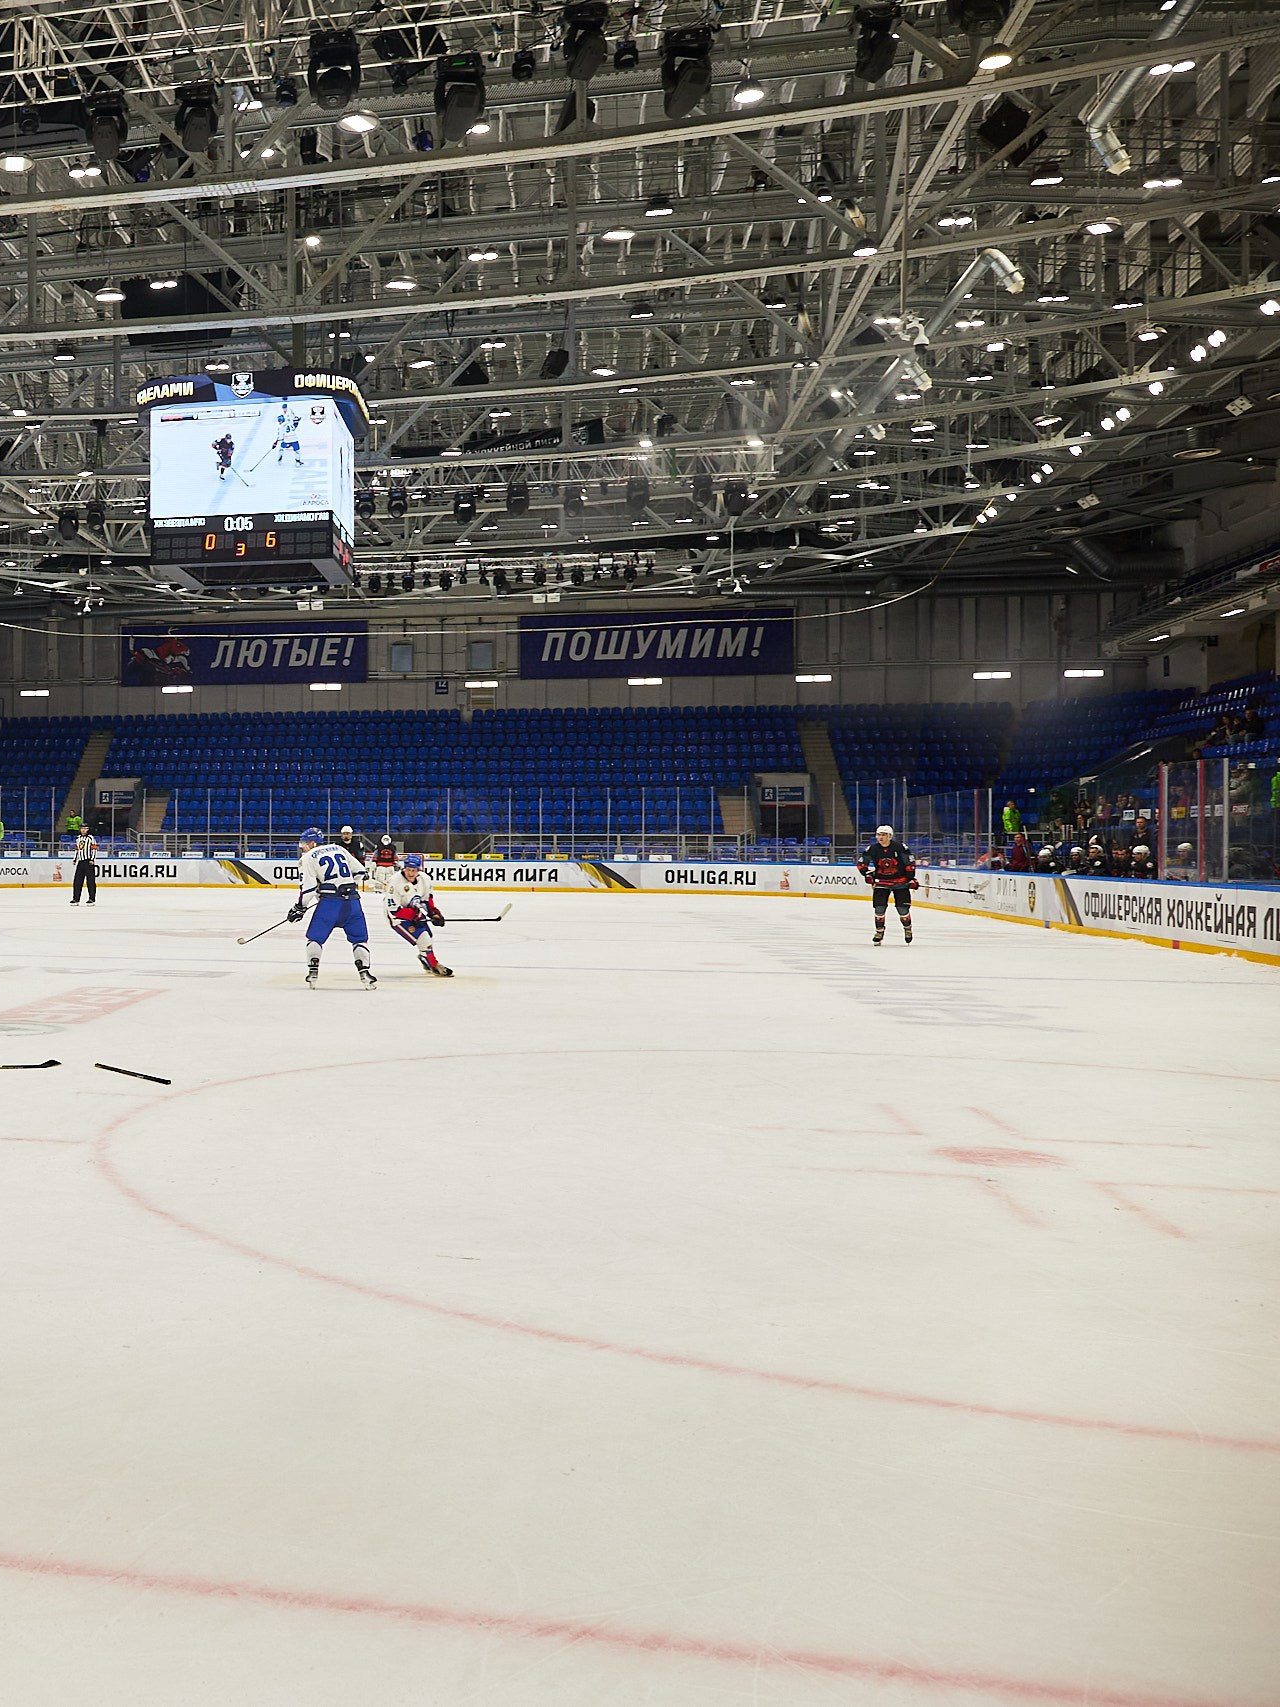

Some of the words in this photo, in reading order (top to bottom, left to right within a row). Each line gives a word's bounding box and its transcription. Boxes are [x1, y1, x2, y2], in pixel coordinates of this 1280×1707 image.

[534, 437, 560, 446] ЛИГИ
[223, 516, 254, 532] 0:05
[205, 533, 216, 550] 0
[265, 531, 276, 547] 6
[236, 543, 246, 556] 3
[210, 637, 355, 669] ЛЮТЫЕ!
[541, 627, 764, 662] ПОШУМИМ!
[320, 853, 351, 881] 26
[425, 863, 506, 882] ККЕЙНАЯ
[513, 868, 559, 882] ЛИГА
[665, 869, 756, 886] OHLIGA.RU
[824, 875, 858, 886] АЛРОСА
[1084, 891, 1162, 926] ОФИЦЕРСКАЯ
[1167, 893, 1257, 938] ХОККЕЙНАЯ
